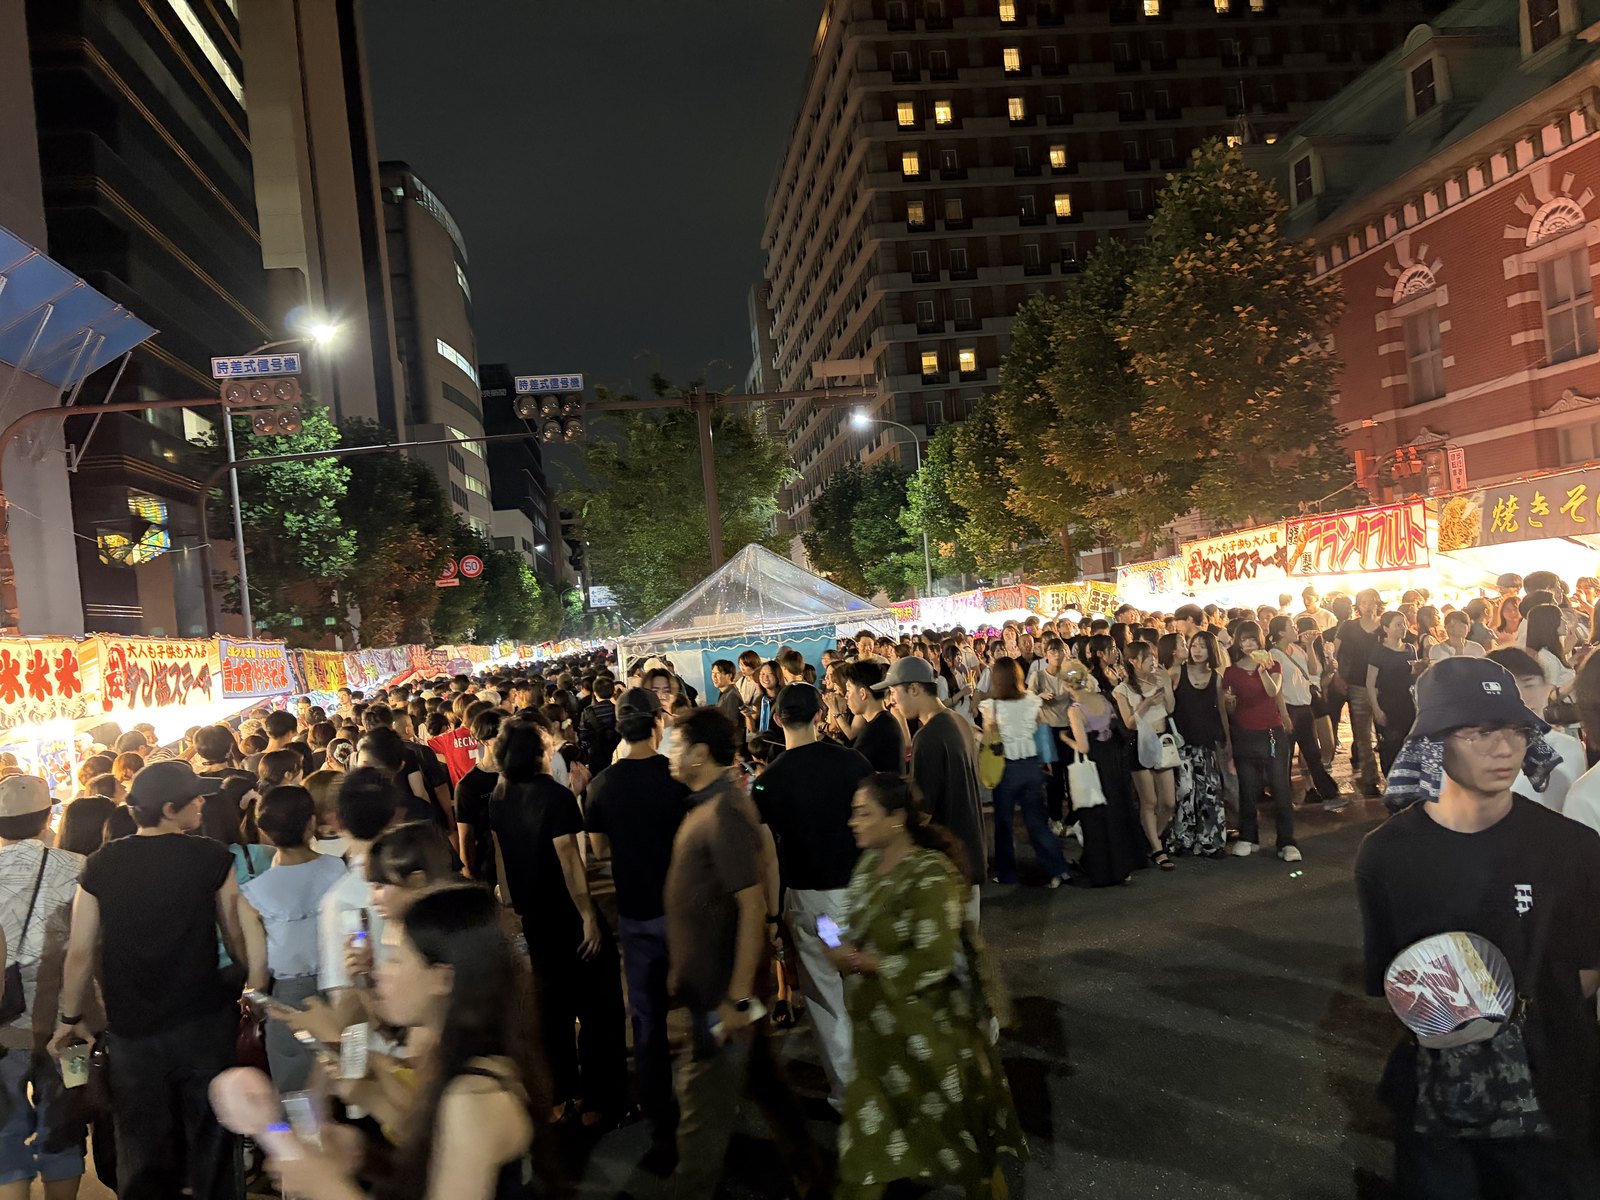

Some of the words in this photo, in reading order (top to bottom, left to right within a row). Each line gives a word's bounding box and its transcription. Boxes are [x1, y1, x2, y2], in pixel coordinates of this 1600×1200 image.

[215, 357, 299, 375] 時差式信号機
[518, 377, 580, 391] 時差式信号機
[1490, 484, 1600, 533] 焼きそ
[1308, 507, 1427, 572] フランクフルト
[465, 561, 478, 572] 50
[1202, 545, 1288, 585] タン塩ステーキ
[223, 657, 289, 694] 富士宮やきそば
[468, 749, 480, 765] 7
